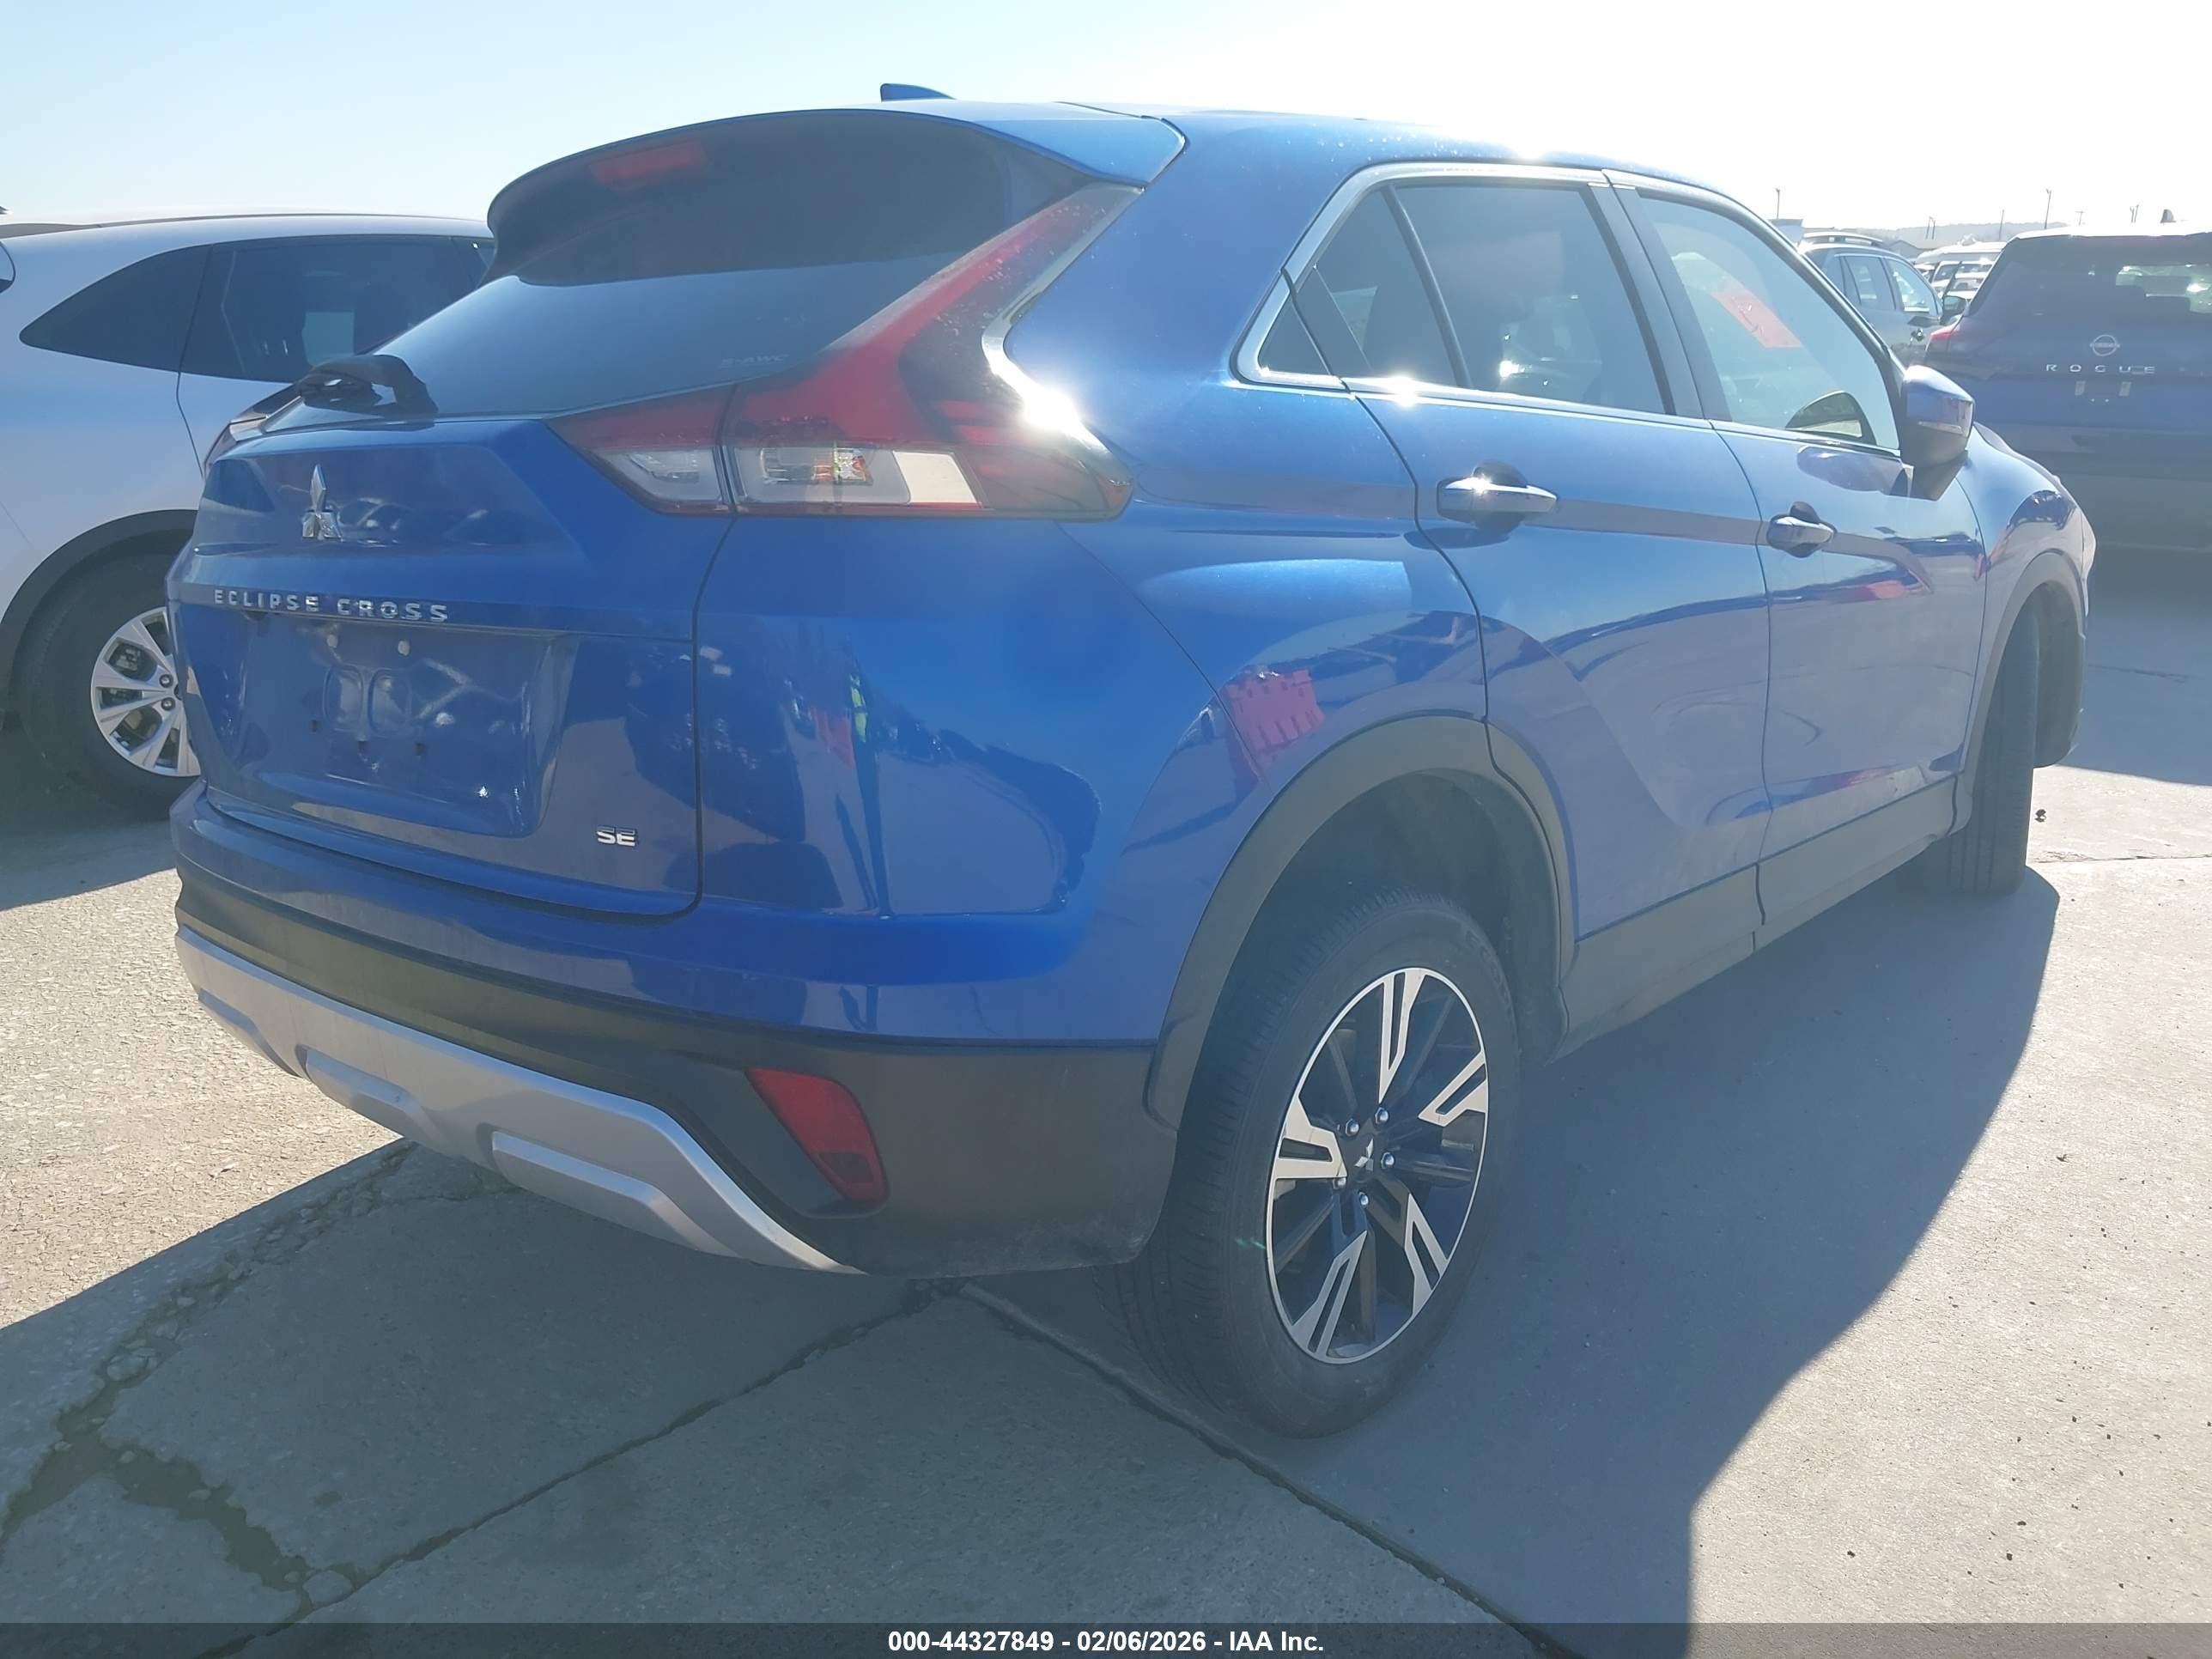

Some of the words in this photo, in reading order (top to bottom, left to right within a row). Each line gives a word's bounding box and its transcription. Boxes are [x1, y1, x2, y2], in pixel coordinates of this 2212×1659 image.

[2045, 363, 2155, 374] ROGUE
[214, 588, 319, 613] ECLIPSE
[337, 598, 448, 623] CROSS
[596, 825, 636, 847] SE
